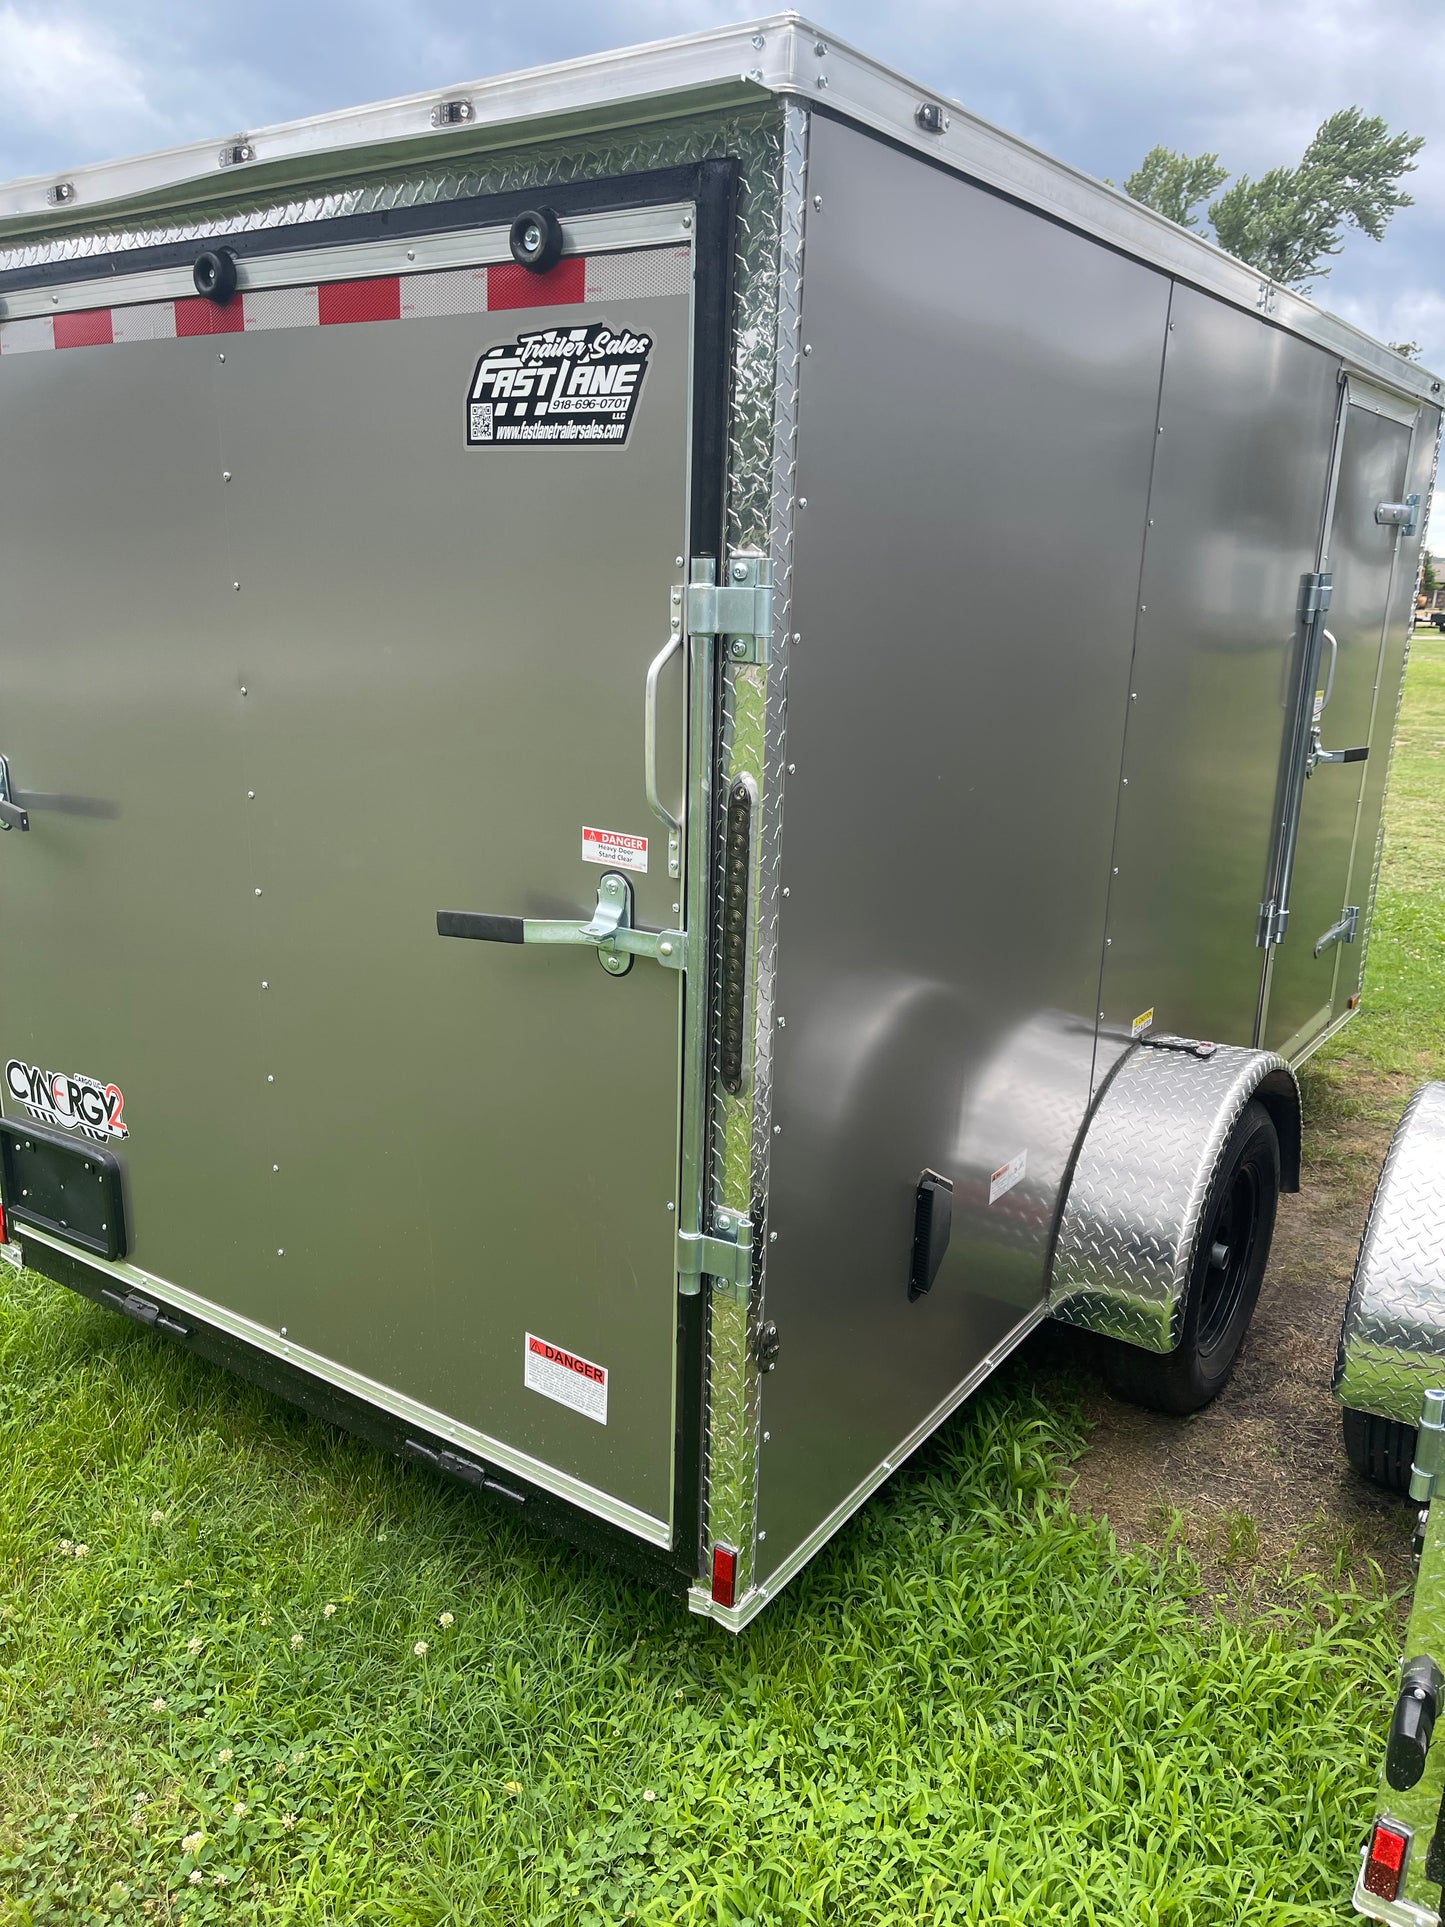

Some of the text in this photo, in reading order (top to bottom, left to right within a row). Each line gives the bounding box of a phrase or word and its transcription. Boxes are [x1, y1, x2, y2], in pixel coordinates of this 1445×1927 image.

[521, 331, 649, 362] Trailer Sales
[552, 398, 628, 410] 918-696-0701
[612, 412, 627, 420] LLC
[496, 419, 625, 440] www.fastlanetrailersales.com
[598, 843, 617, 853] Heavy
[601, 833, 644, 850] DANGER
[598, 850, 616, 860] Stand
[617, 854, 633, 863] Clear
[545, 1345, 604, 1384] DANGER
